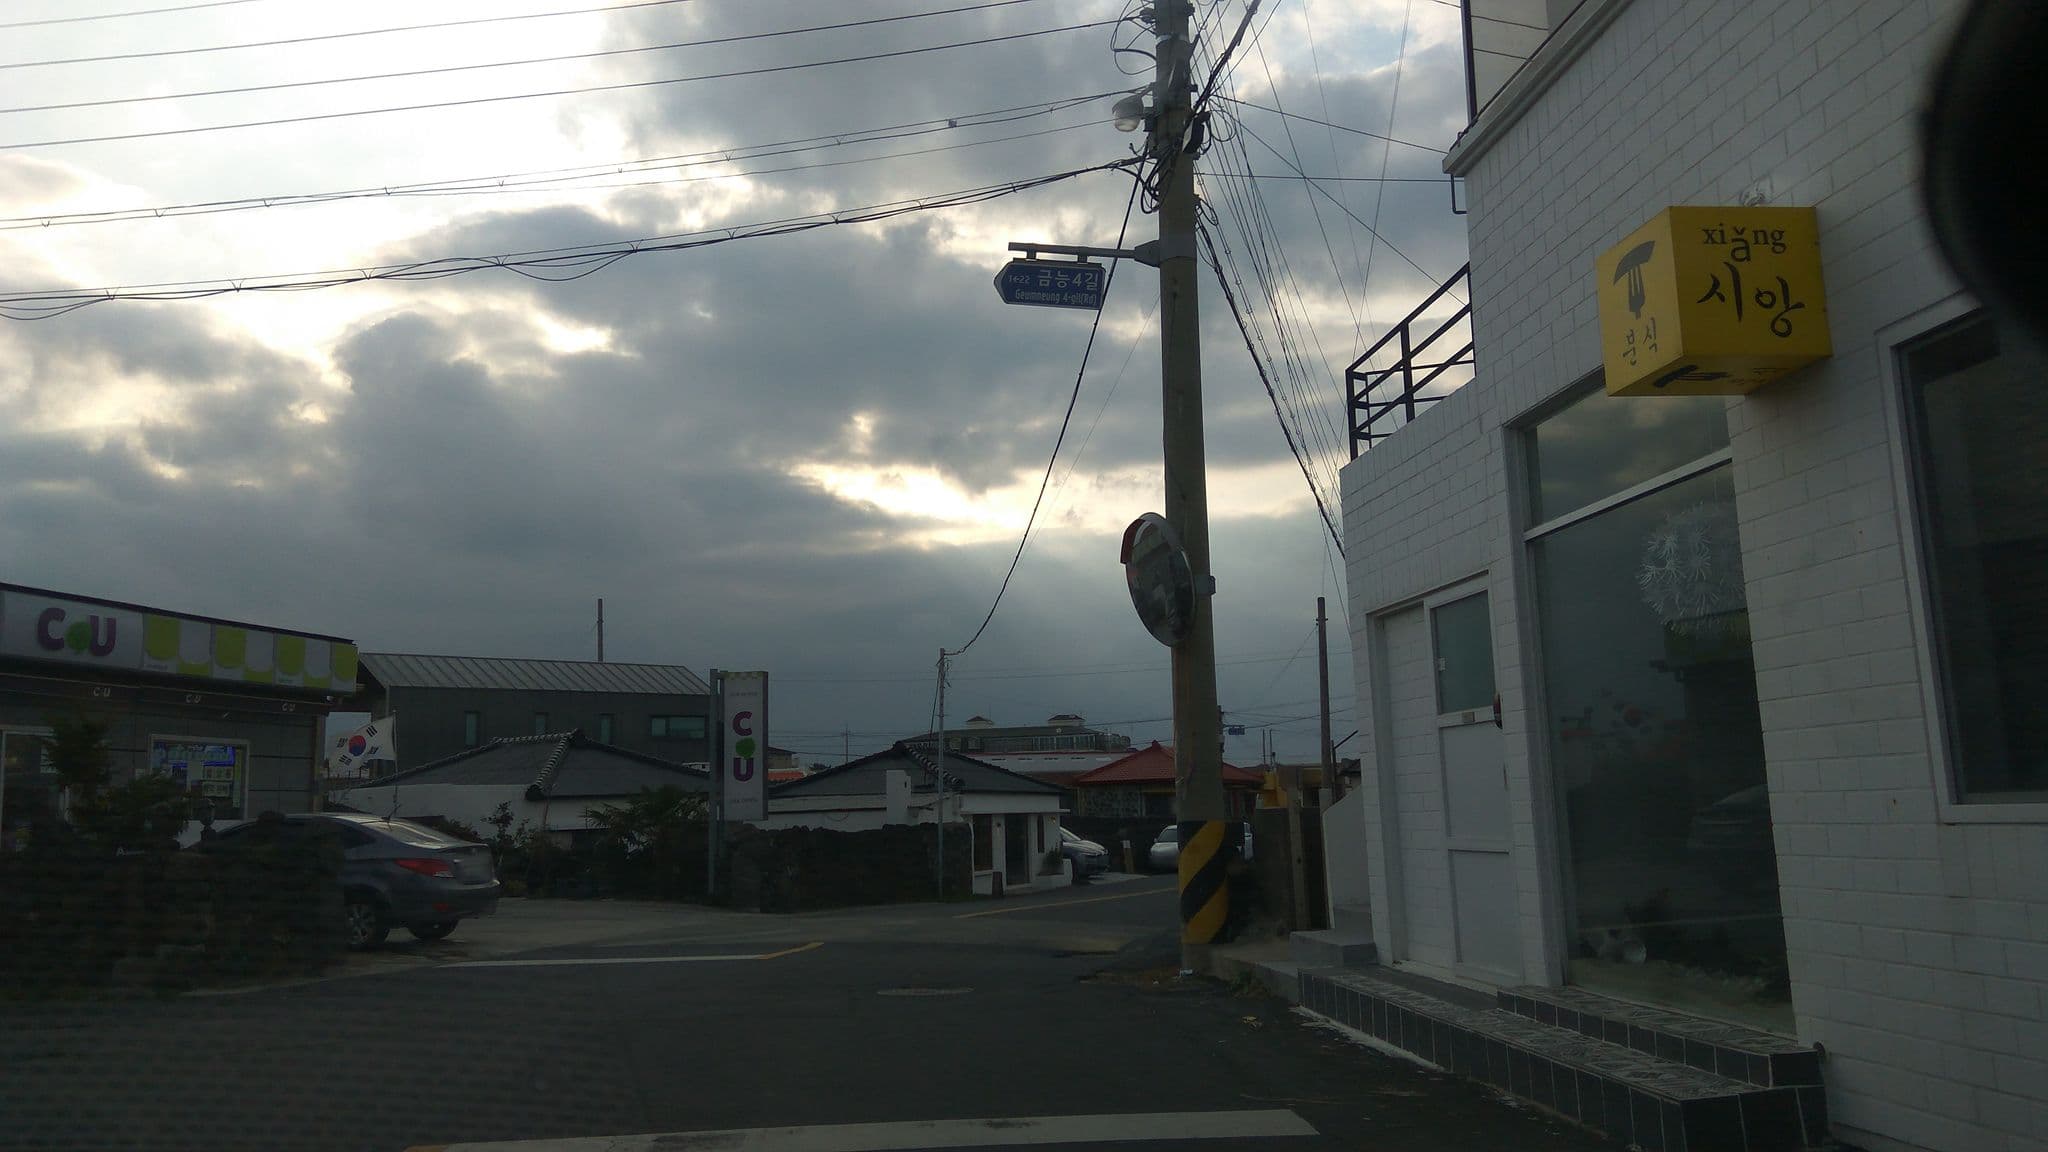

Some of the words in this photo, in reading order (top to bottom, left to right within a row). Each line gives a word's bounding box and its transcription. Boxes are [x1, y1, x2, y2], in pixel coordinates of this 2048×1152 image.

[1038, 269, 1099, 291] 금능4길
[1696, 261, 1805, 338] 시앙
[1622, 317, 1658, 366] 분식
